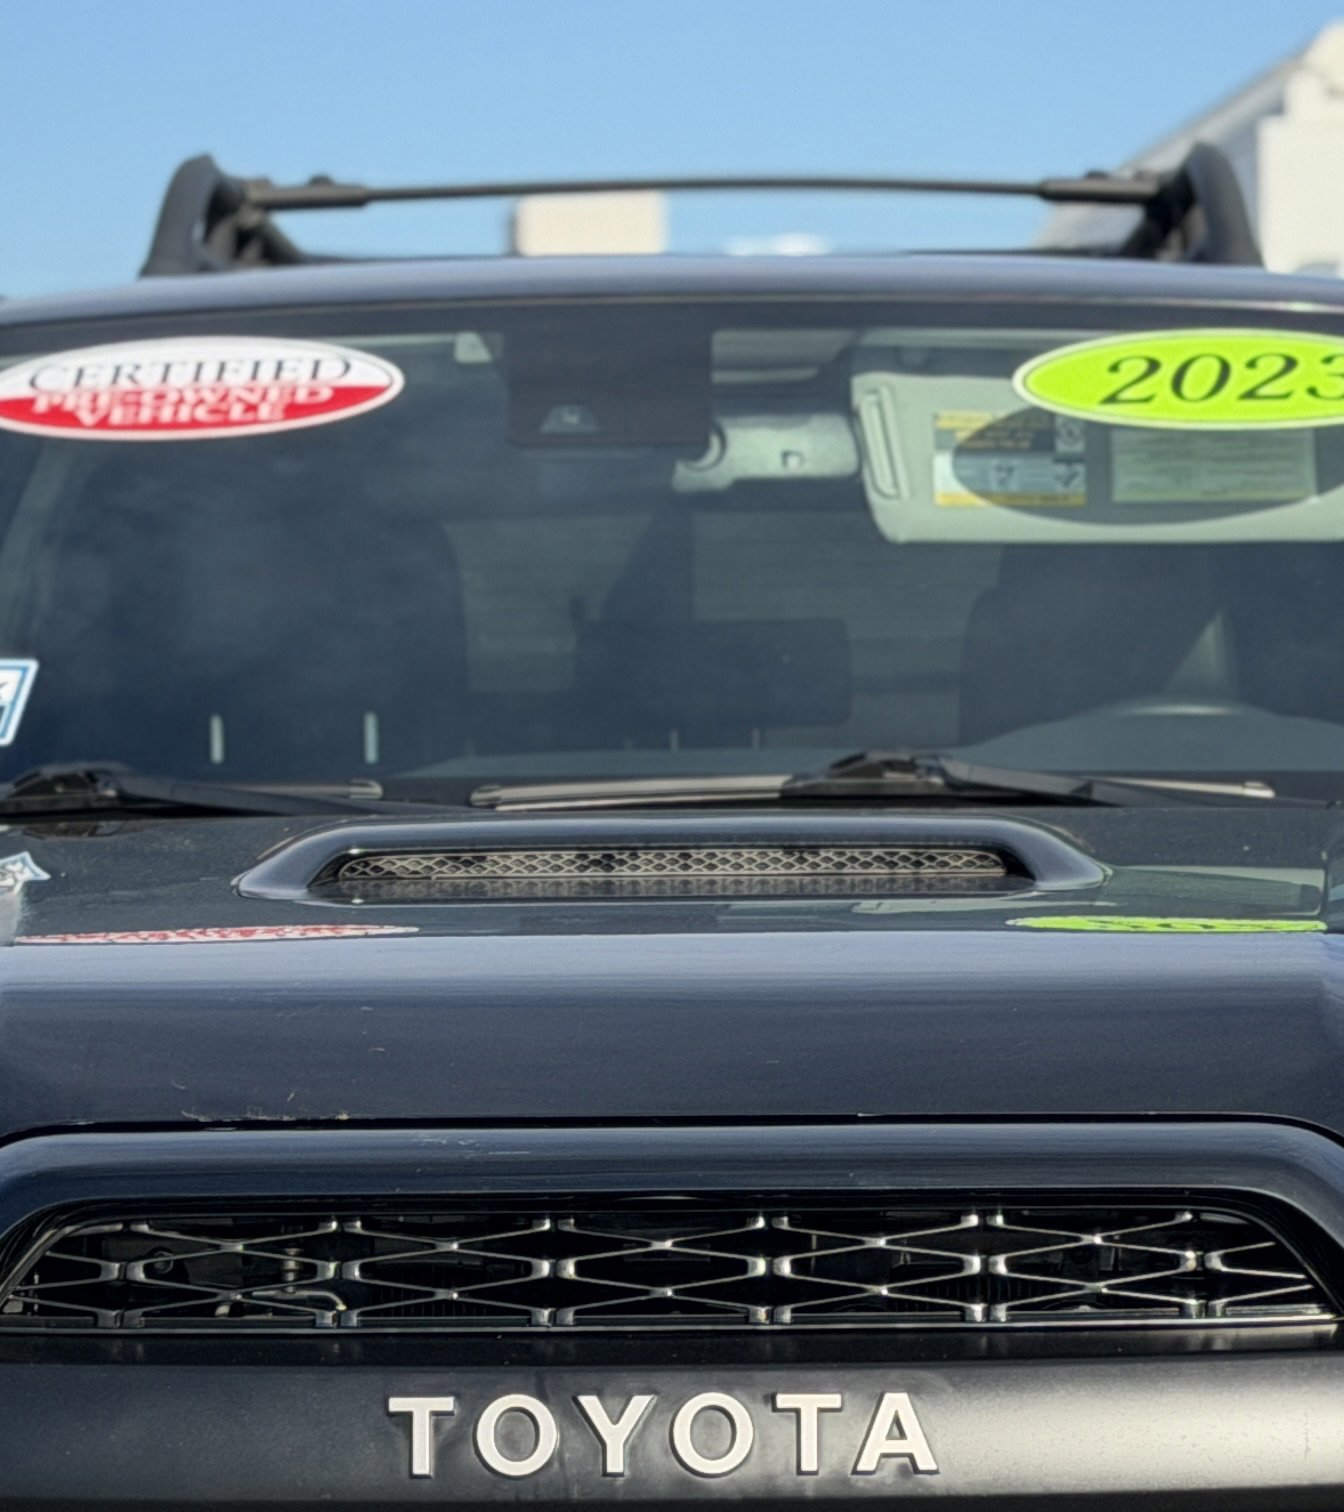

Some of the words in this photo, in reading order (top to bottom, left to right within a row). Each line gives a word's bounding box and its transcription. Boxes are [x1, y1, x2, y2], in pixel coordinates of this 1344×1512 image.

[28, 358, 352, 392] CERTIFIED
[74, 401, 286, 427] VEHICLE
[387, 1391, 940, 1477] TOYOTA
